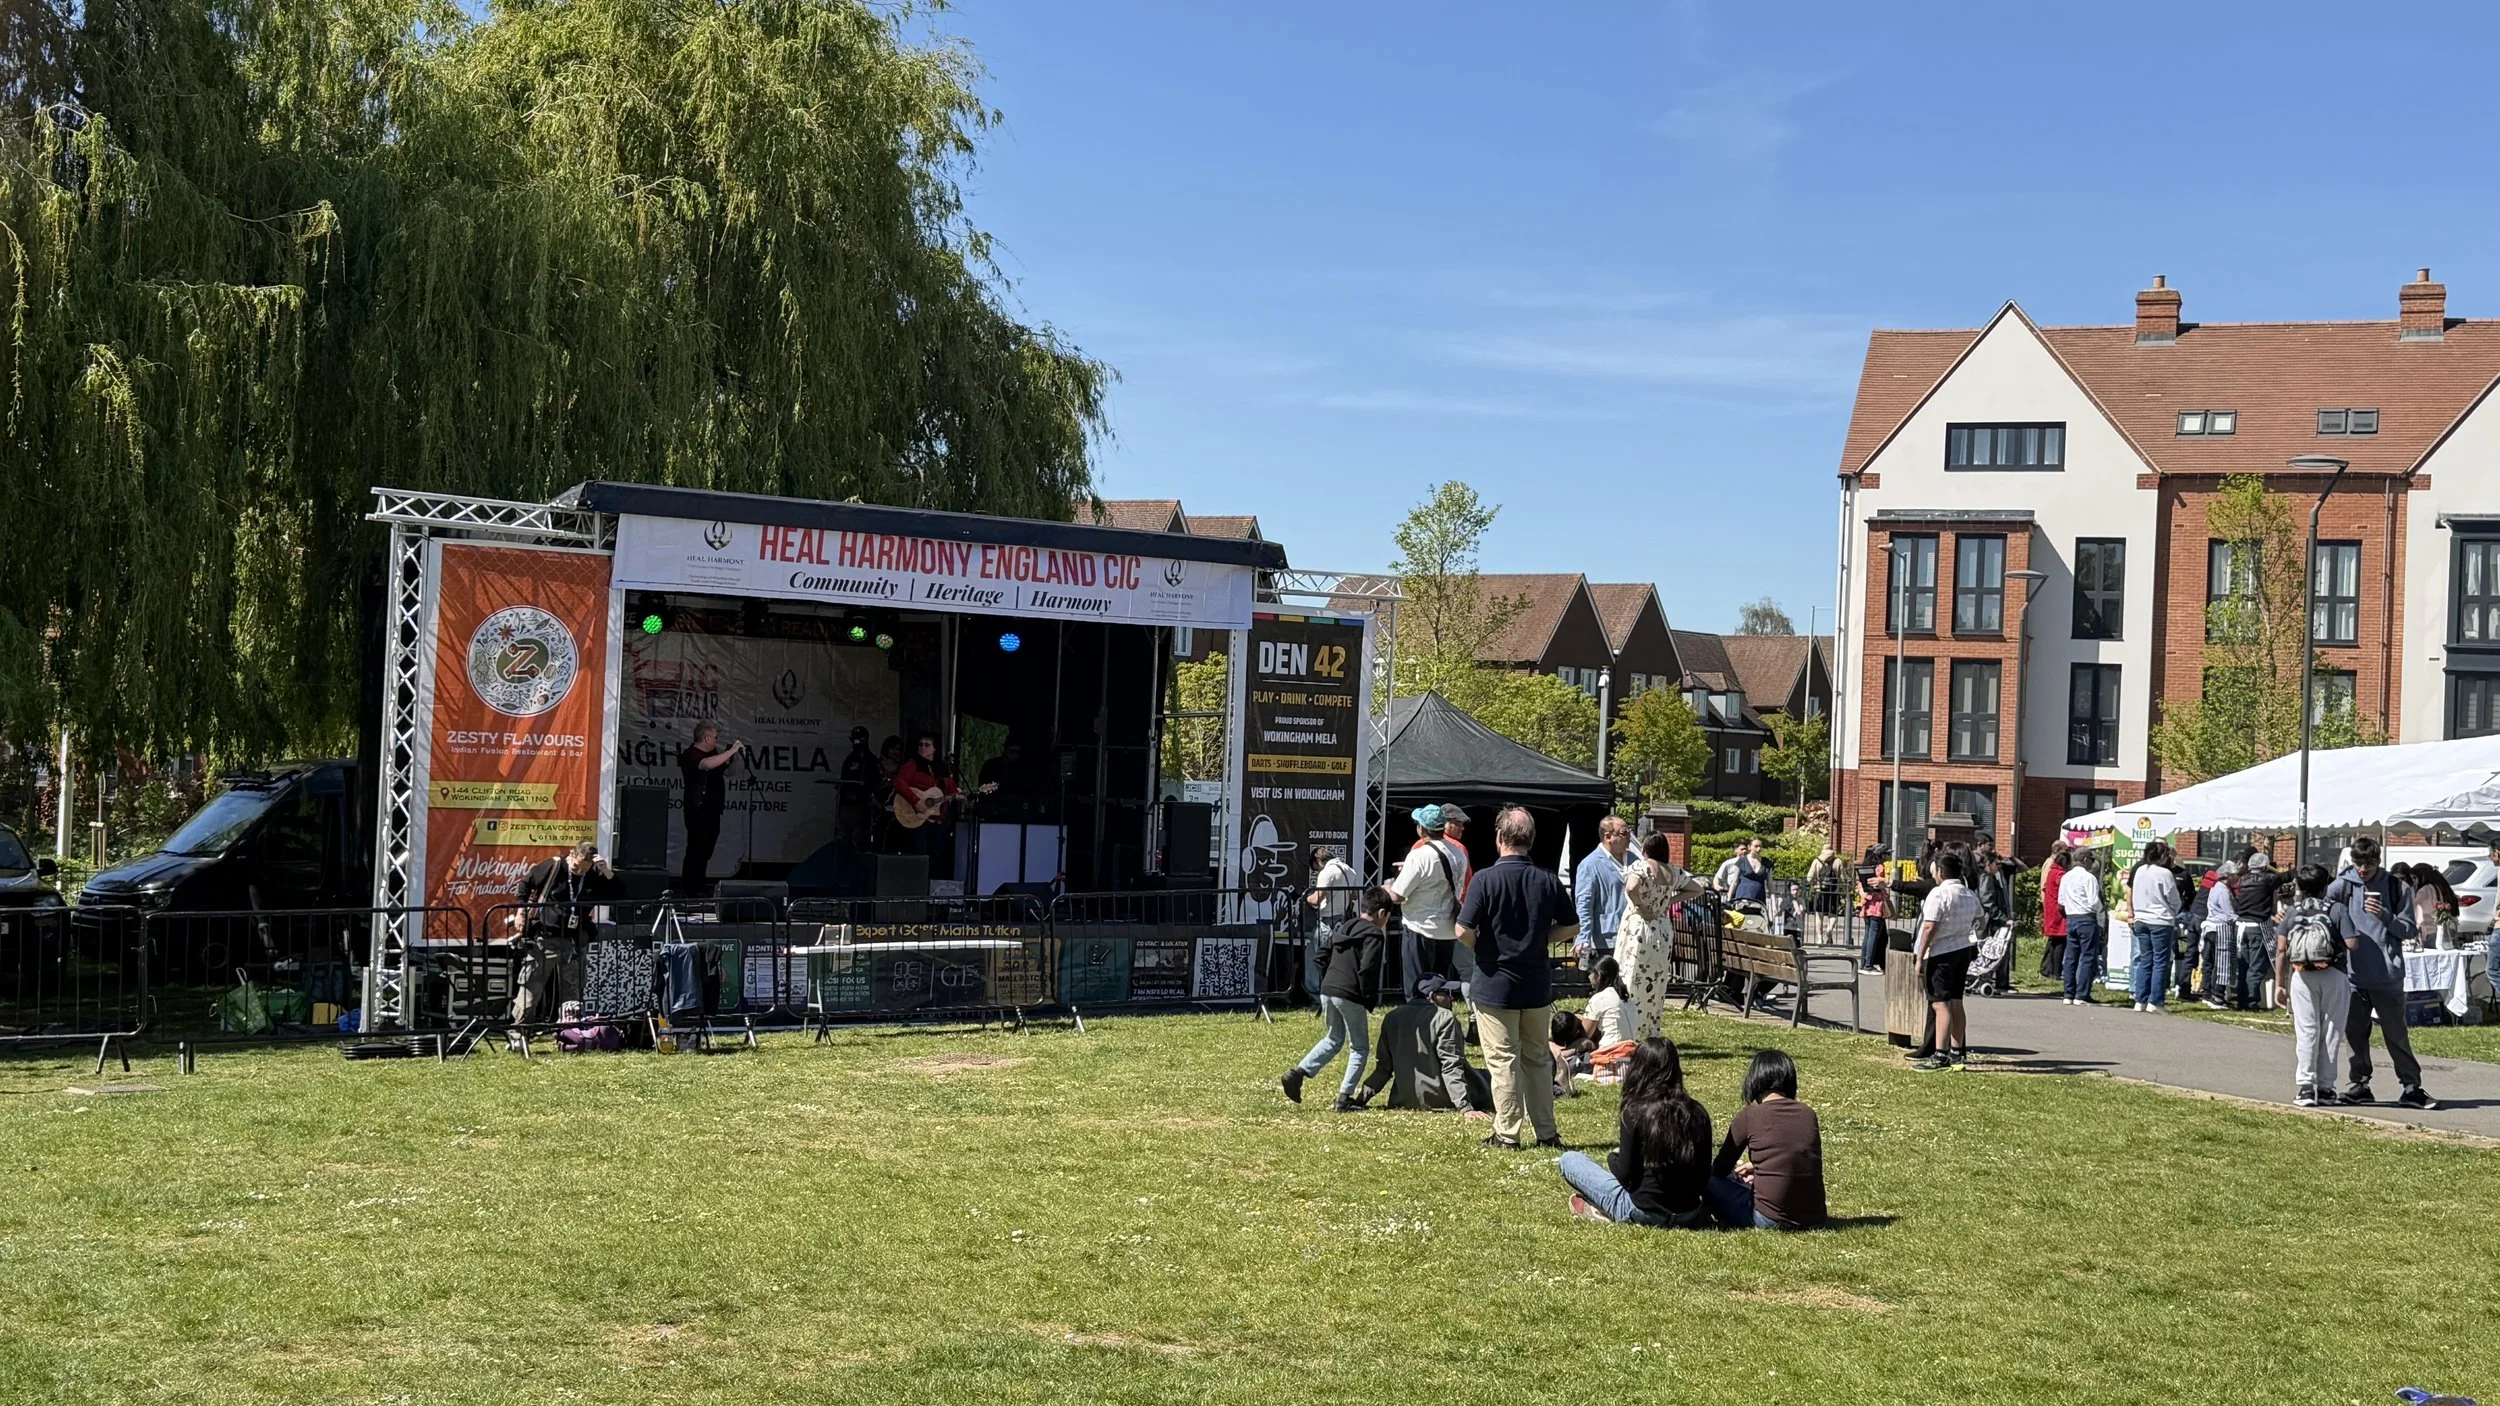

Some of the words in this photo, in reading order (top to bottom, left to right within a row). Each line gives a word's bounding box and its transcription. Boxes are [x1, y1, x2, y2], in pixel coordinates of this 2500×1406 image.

[686, 555, 706, 563] HEAL
[760, 525, 830, 566] HEAL
[838, 531, 973, 577] HARMONY
[980, 544, 1096, 587] ENGLAND
[1103, 555, 1141, 590] CIC
[789, 571, 899, 599] Community
[925, 582, 1004, 608] Heritage
[1030, 591, 1112, 616] Harmony
[1258, 641, 1309, 676] DEN
[1314, 645, 1346, 678] 42
[1253, 690, 1274, 703] PLAY
[1280, 692, 1307, 705] DRINK
[1313, 694, 1353, 708] COMPETE
[447, 730, 498, 744] ZESTY
[503, 732, 585, 748] FLAVOURS
[1263, 730, 1313, 744] WOKINGHAM
[1315, 732, 1337, 745] MELA
[451, 746, 477, 754] Indian
[745, 744, 831, 773] MELA
[1251, 758, 1272, 768] DARTS
[1276, 759, 1327, 770] SHUFFLEBOARD
[1331, 761, 1347, 771] GOLF
[1251, 786, 1271, 799] VISIT
[1272, 787, 1283, 799] US
[1284, 788, 1293, 800] IN
[1295, 788, 1345, 801] WOKINGHAM
[721, 801, 747, 812] SIAN
[1309, 830, 1324, 839] SCAN
[1324, 831, 1333, 839] TO
[1333, 831, 1348, 840] BOOK
[456, 853, 537, 887] Wokingh
[856, 924, 897, 938] Expert
[940, 924, 980, 936] Maths
